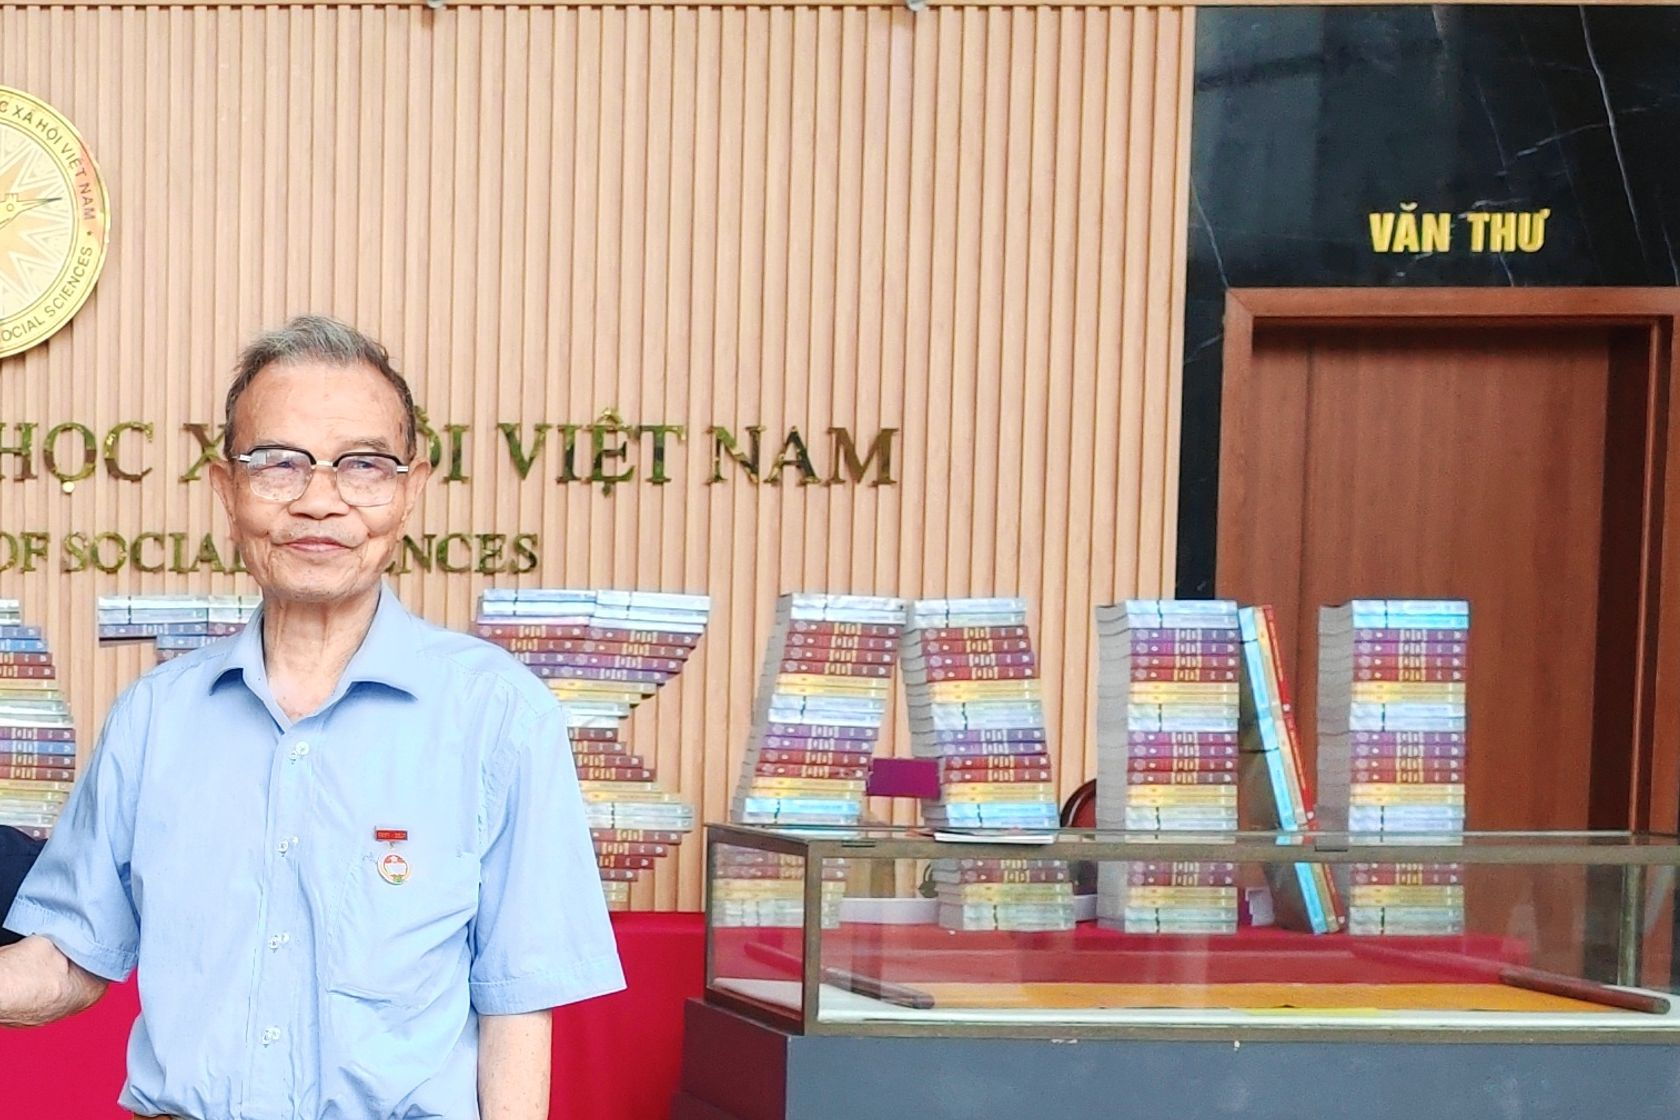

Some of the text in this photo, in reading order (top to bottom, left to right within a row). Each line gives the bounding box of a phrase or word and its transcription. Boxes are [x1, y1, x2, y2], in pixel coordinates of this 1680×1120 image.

[79, 182, 97, 221] NAM
[1369, 201, 1551, 253] VĂN THƯ
[43, 246, 93, 318] SCIENCES
[496, 407, 687, 498] VIỆT
[705, 425, 900, 487] NAM
